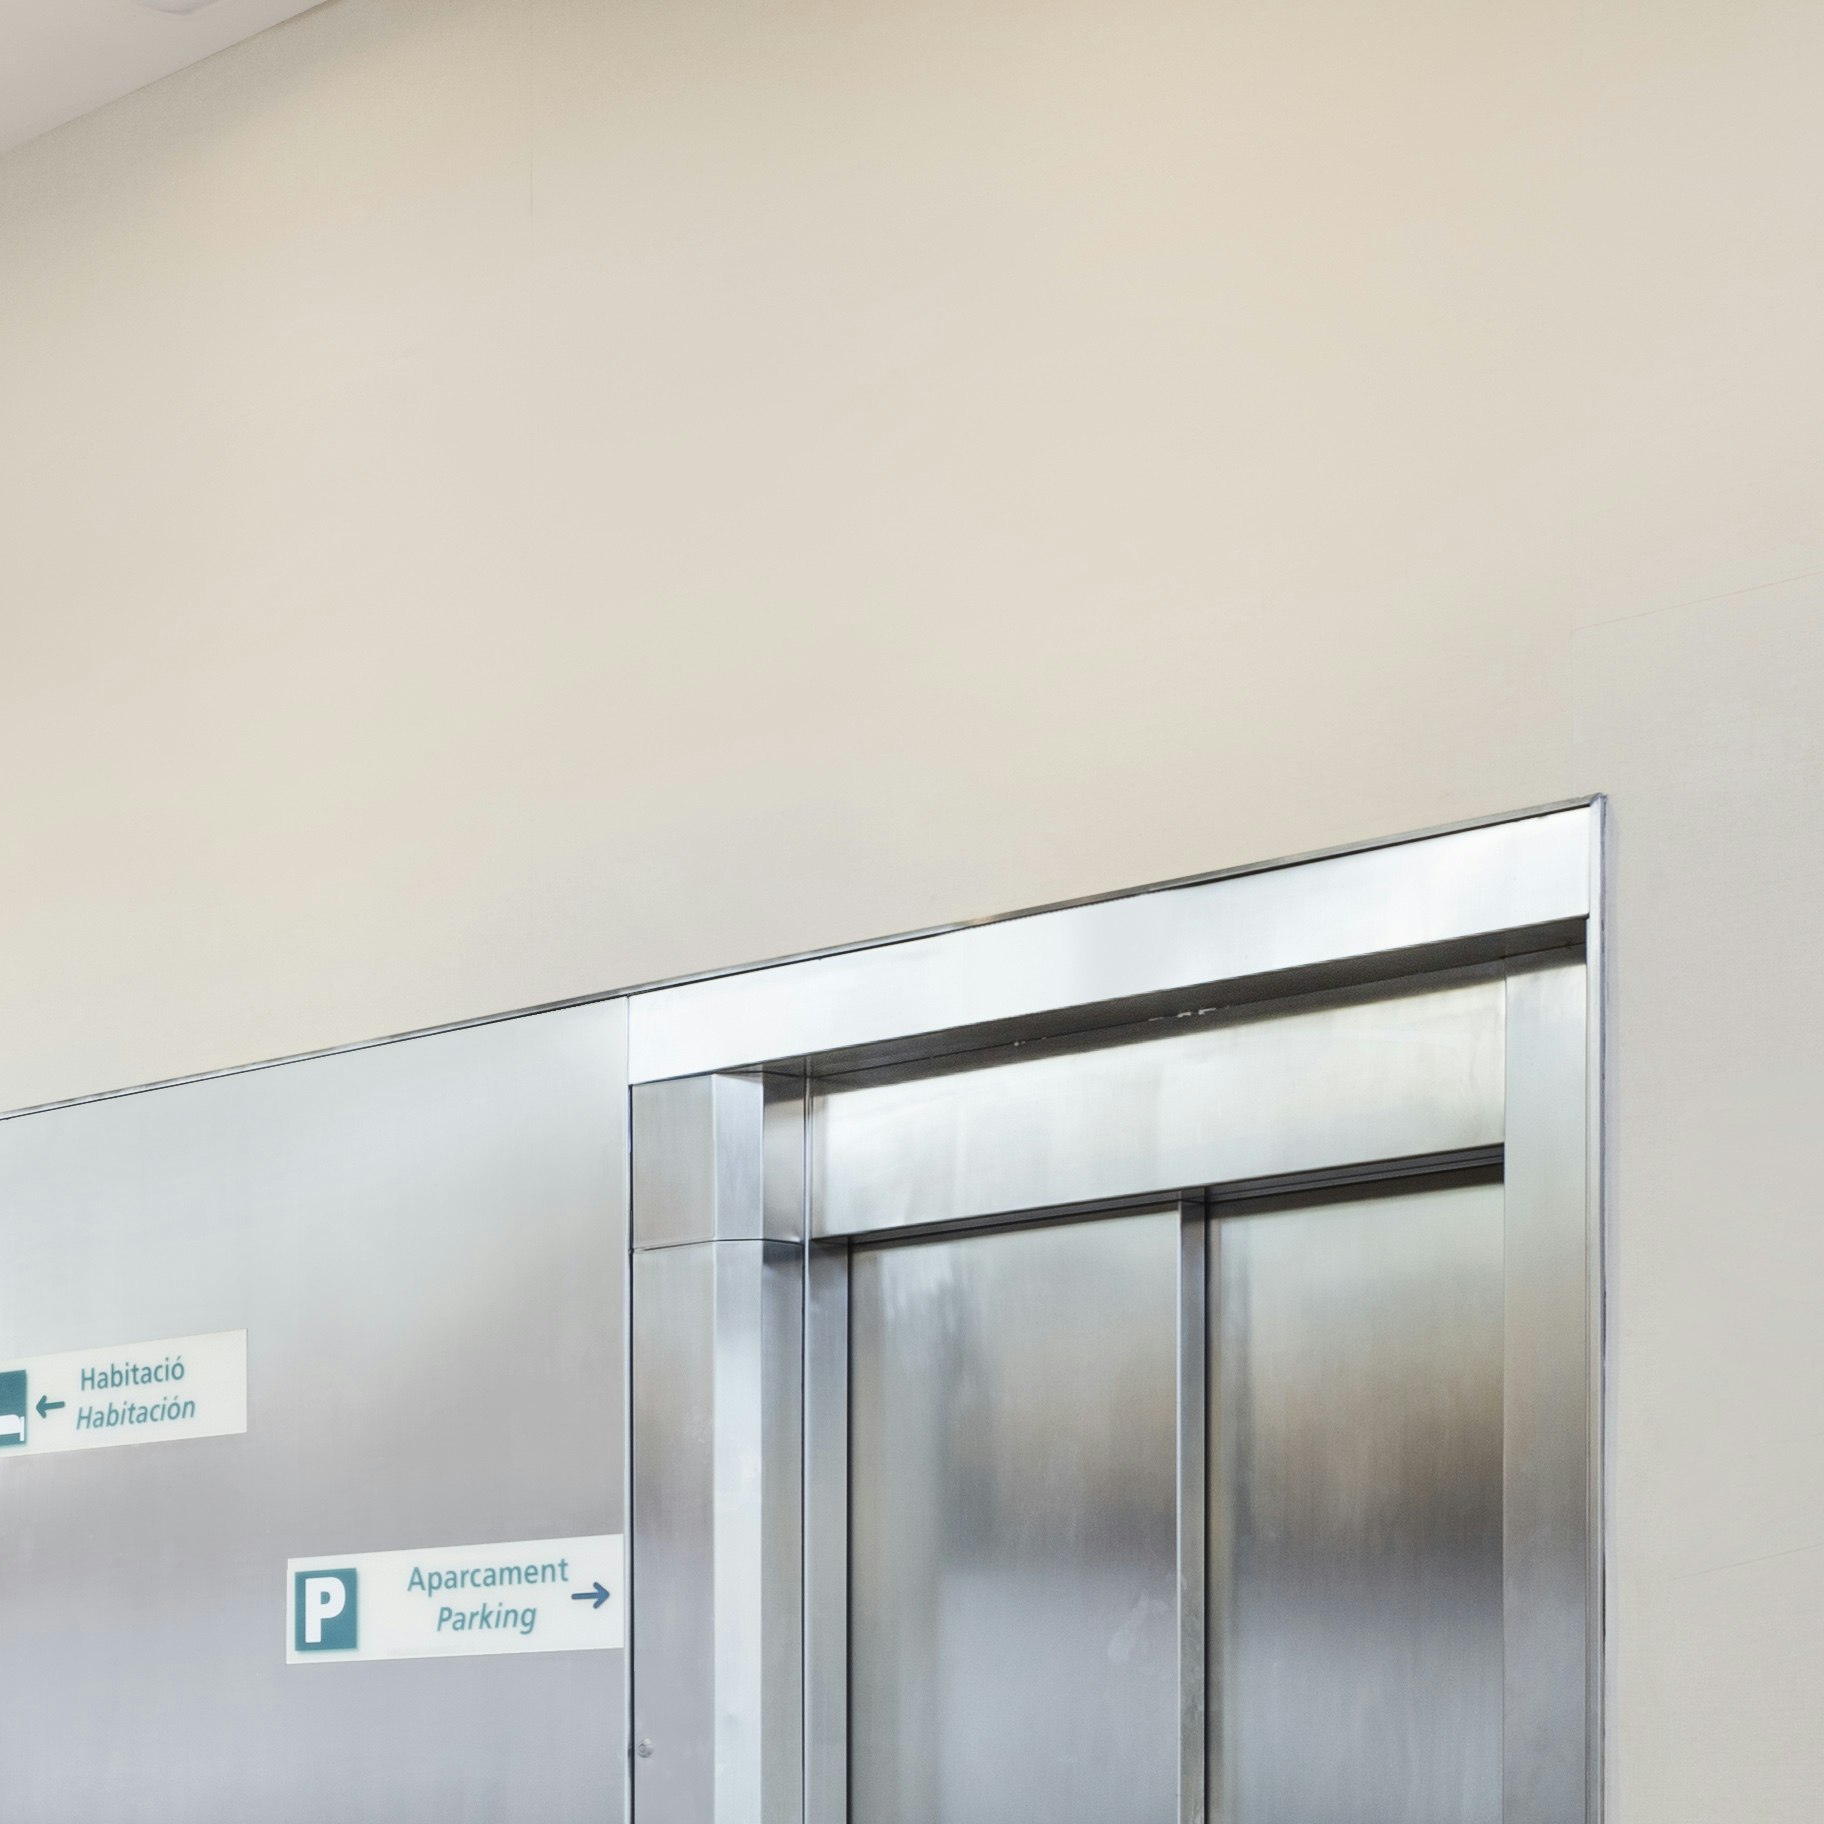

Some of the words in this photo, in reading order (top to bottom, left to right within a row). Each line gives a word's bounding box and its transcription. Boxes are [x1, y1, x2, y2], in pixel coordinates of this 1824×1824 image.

[80, 1355, 186, 1391] Habitació
[76, 1396, 196, 1430] Habitación
[407, 1558, 569, 1597] Aparcament
[304, 1576, 347, 1644] P
[436, 1602, 537, 1635] Parking
